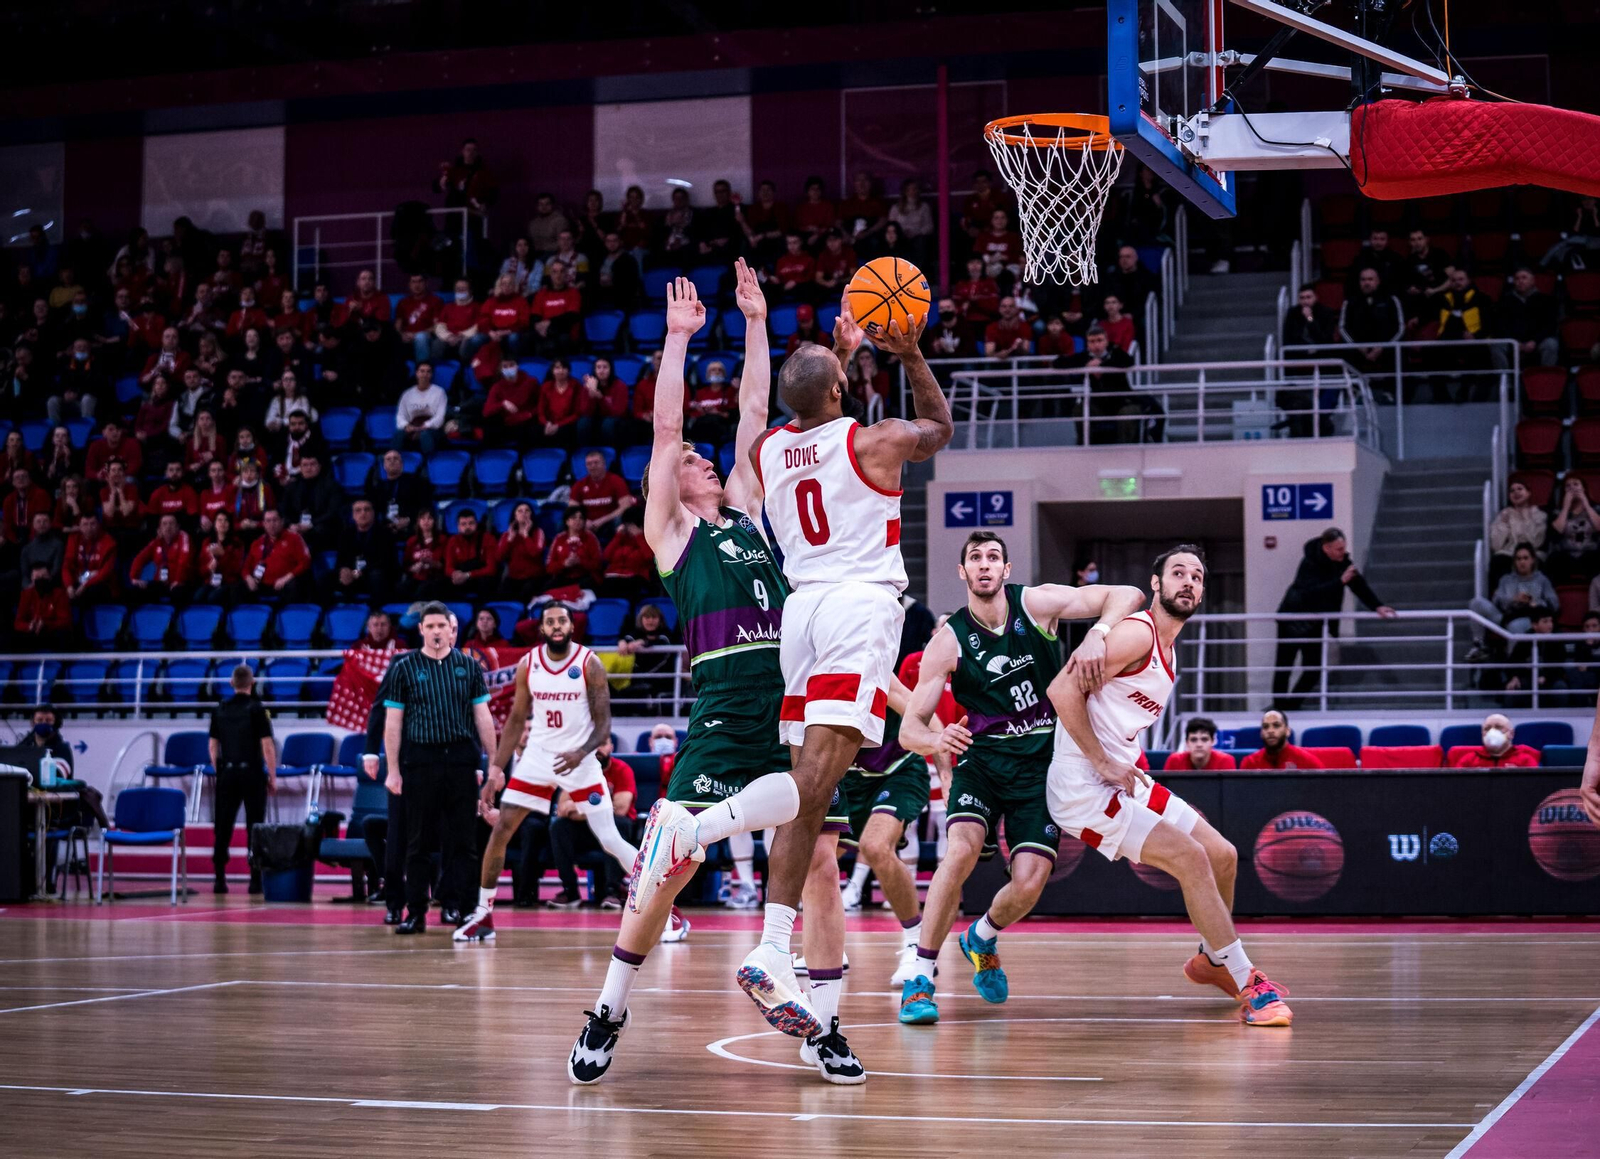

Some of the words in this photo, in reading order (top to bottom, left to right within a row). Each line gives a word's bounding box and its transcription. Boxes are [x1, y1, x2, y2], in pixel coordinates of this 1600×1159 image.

[784, 444, 820, 469] DOWE
[990, 493, 1005, 511] 9
[1265, 487, 1292, 506] 10
[794, 478, 831, 547] 0
[753, 578, 770, 612] 9
[1009, 680, 1040, 712] 32
[1127, 690, 1164, 718] PROM
[546, 710, 564, 729] 20
